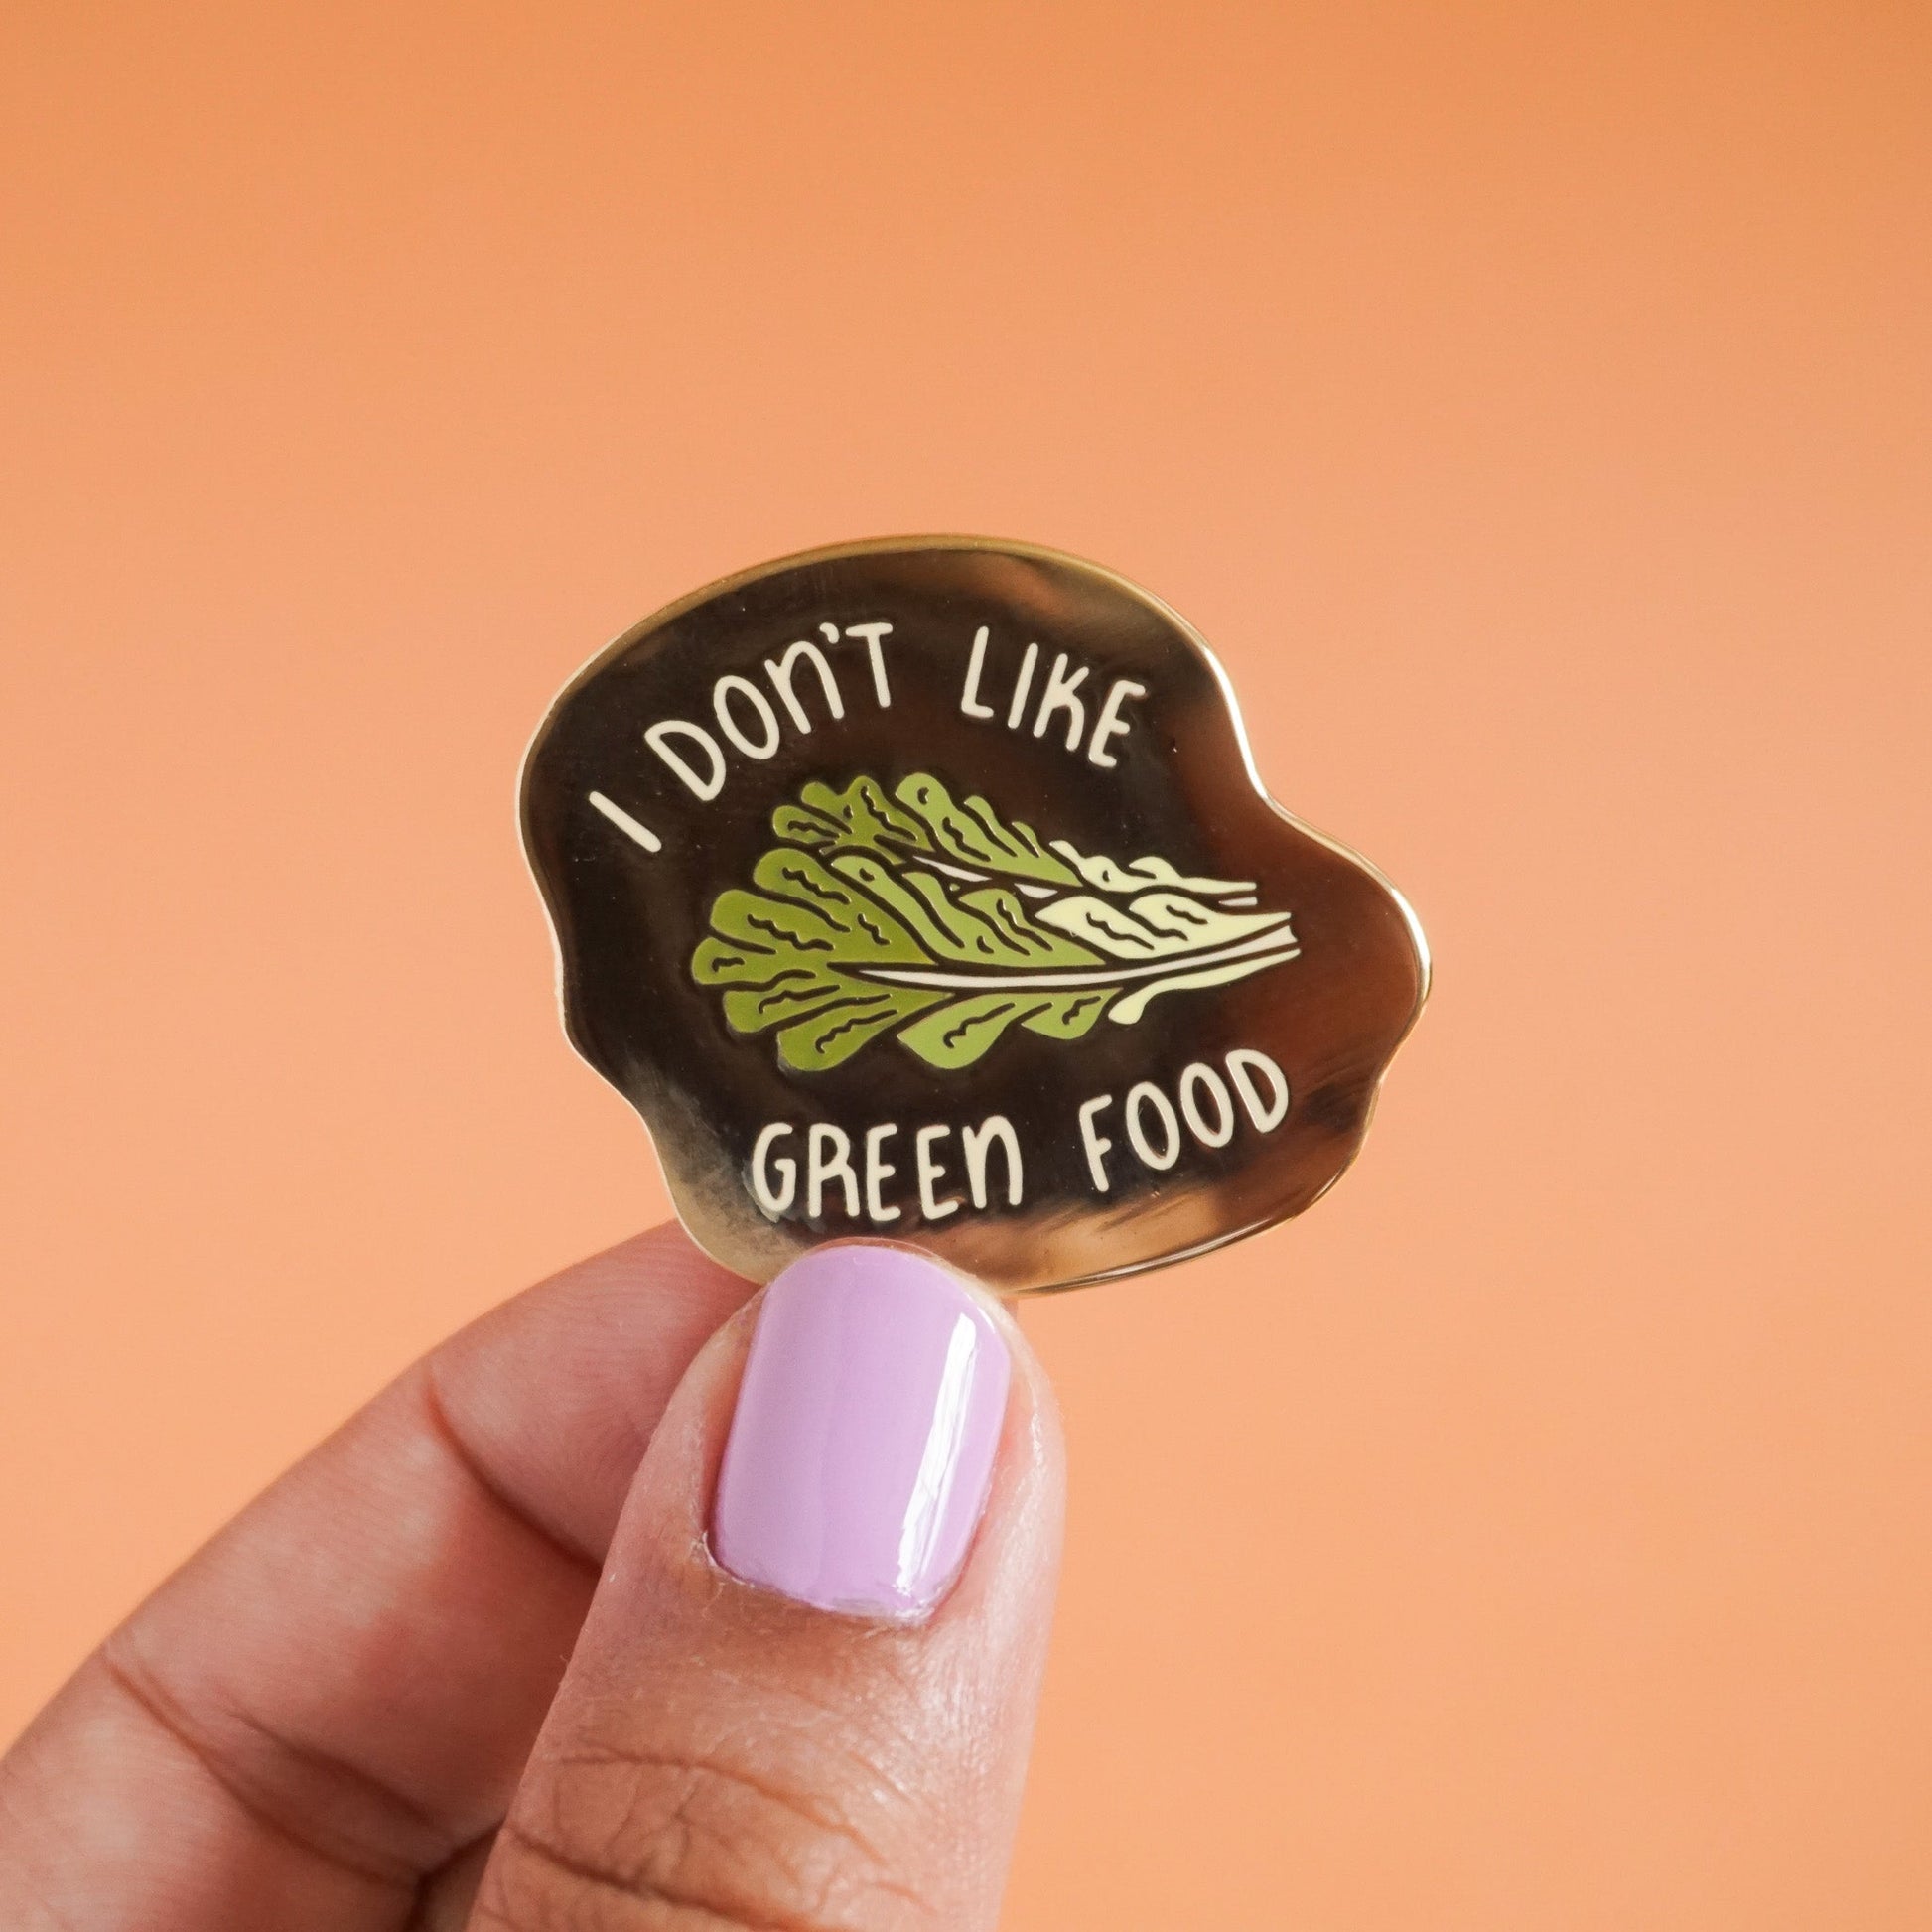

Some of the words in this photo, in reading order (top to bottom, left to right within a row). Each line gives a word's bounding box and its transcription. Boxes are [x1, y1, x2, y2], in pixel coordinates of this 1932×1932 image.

[589, 790, 663, 854] I
[960, 625, 1147, 768] LIKE
[1078, 1048, 1290, 1193] FOOD
